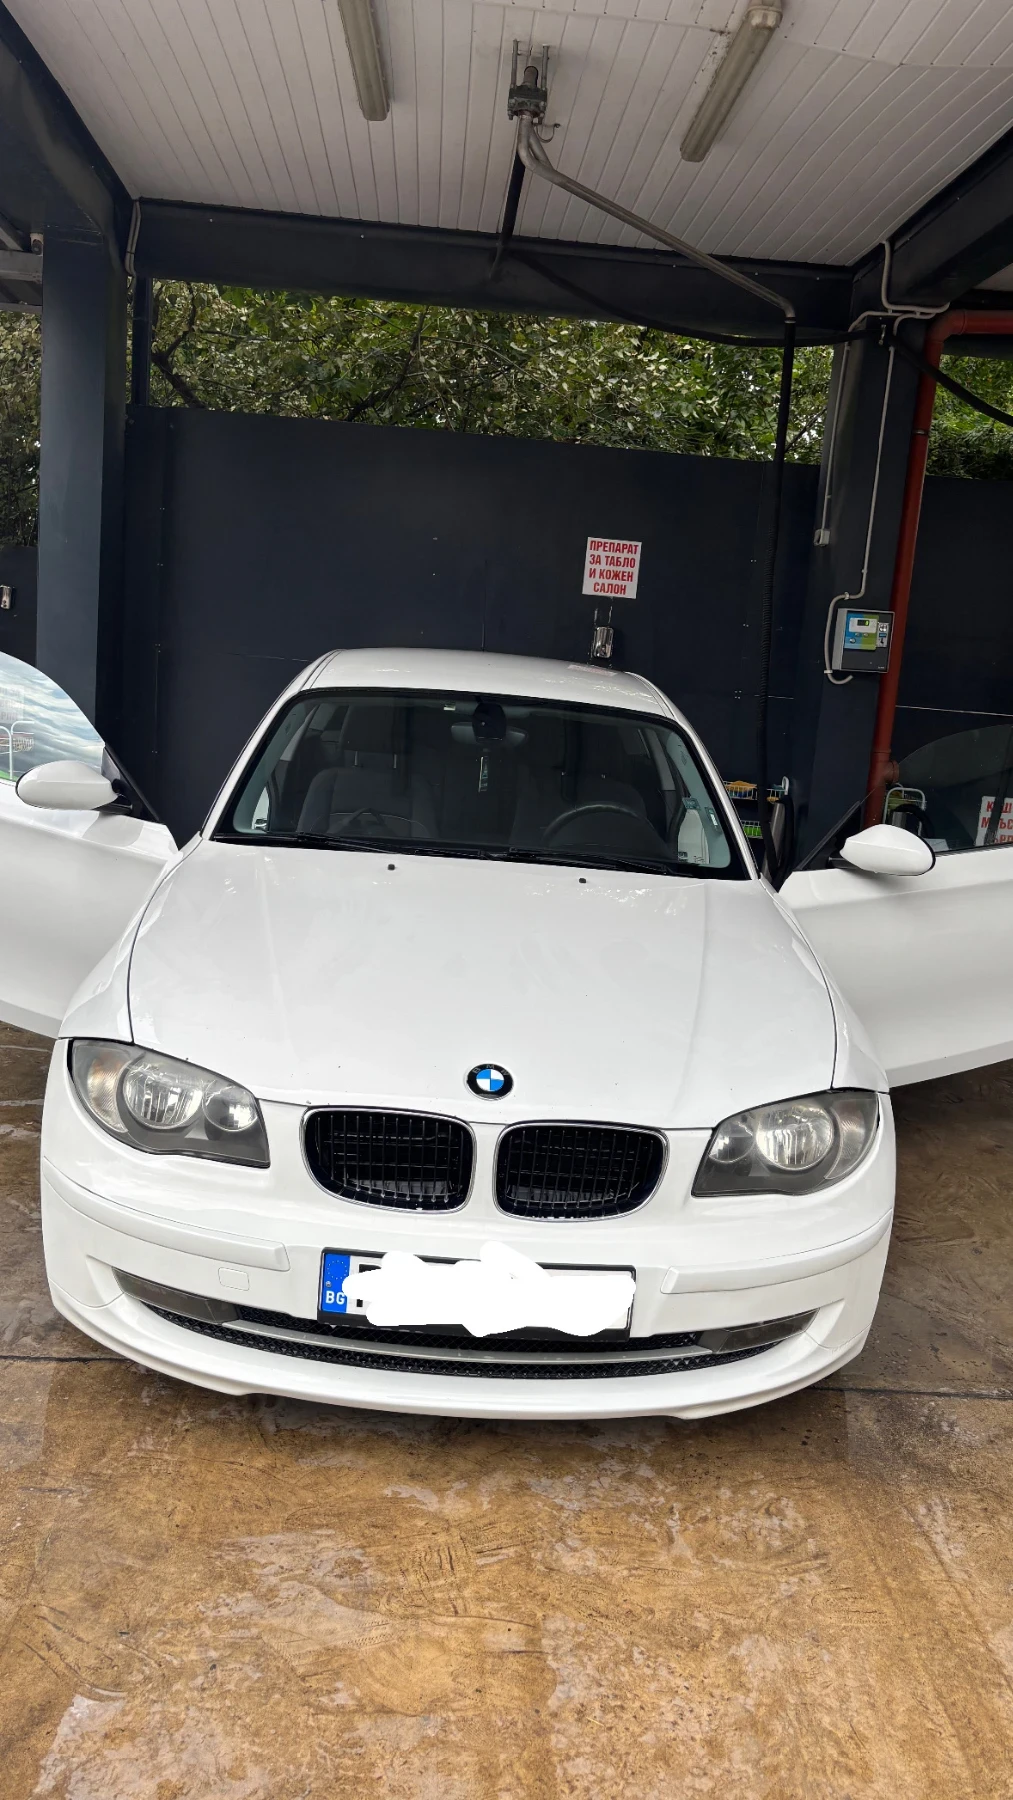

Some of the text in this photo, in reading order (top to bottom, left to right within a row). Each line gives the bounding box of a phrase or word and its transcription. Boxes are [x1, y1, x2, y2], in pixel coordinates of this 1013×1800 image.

[589, 540, 639, 555] ПРЕПАРАТ
[589, 554, 636, 568] ЗА ТАБЛО
[589, 568, 634, 582] И КОЖЕН
[593, 582, 627, 595] САЛОН
[325, 1290, 346, 1305] BG
